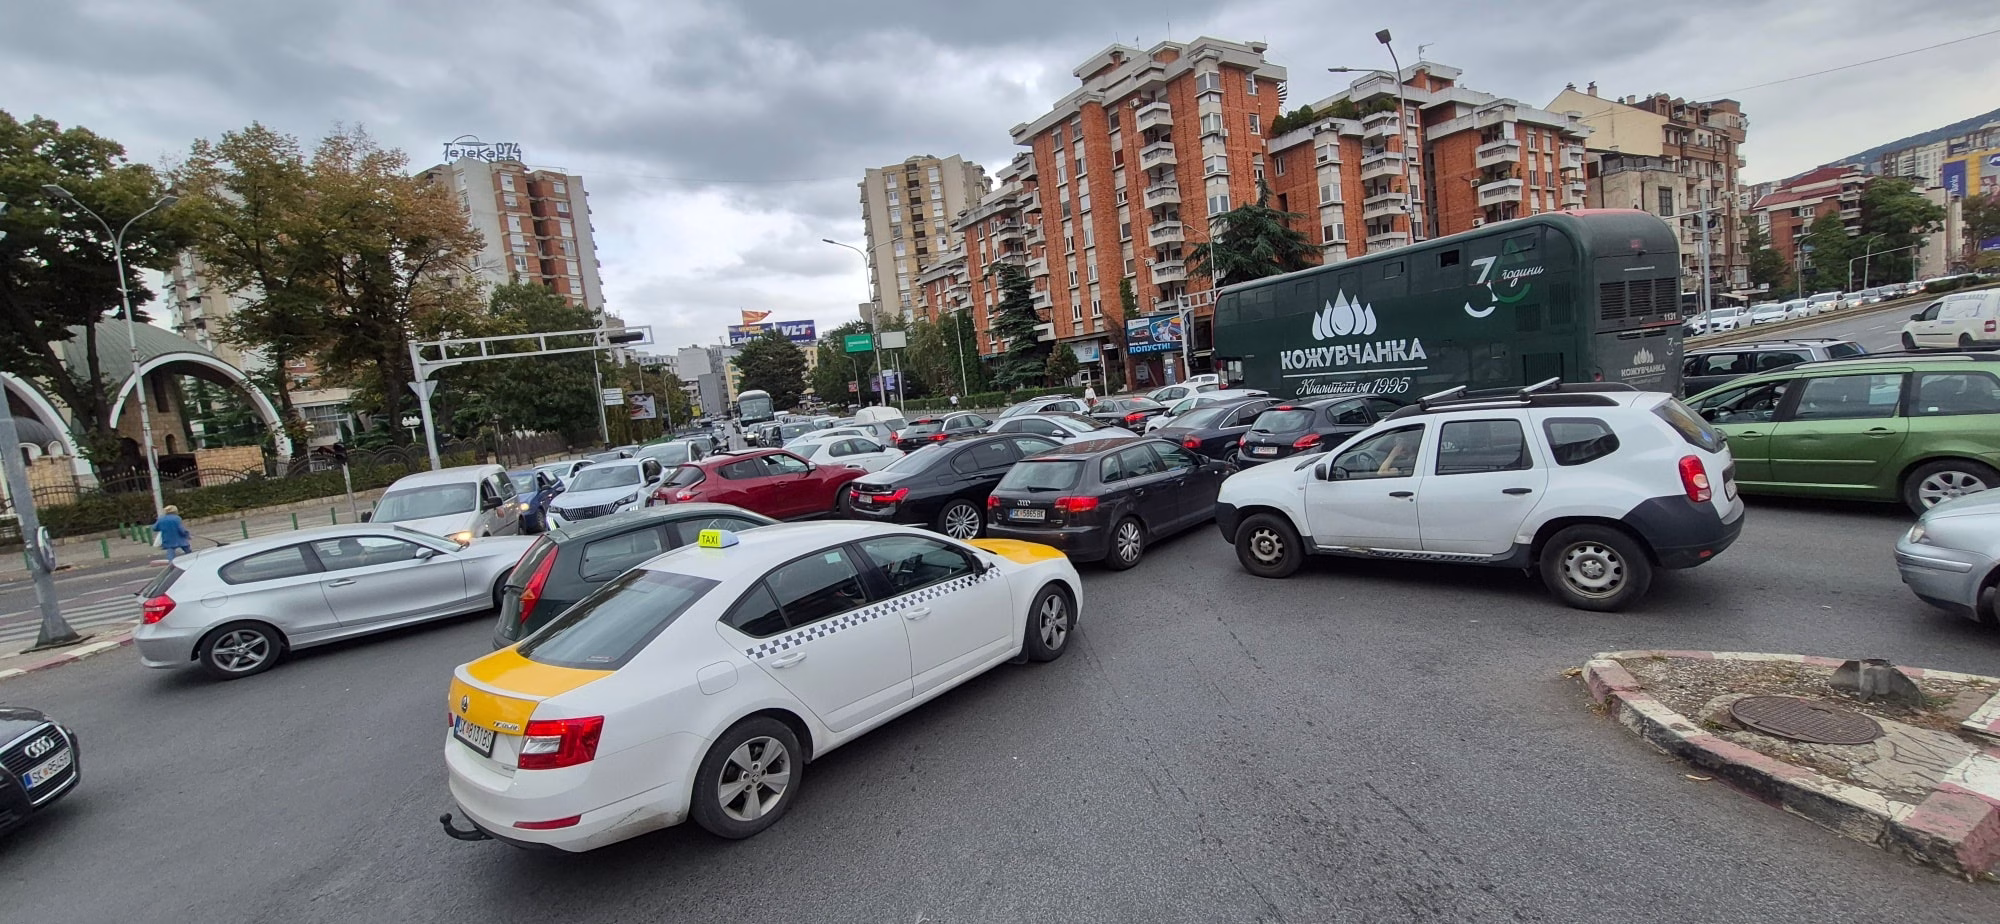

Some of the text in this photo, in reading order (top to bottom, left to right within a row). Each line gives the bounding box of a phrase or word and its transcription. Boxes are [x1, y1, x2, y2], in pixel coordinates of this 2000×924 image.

[781, 325, 809, 336] VLT
[1129, 343, 1171, 353] ПОПУСТИ!
[1280, 337, 1427, 370] КОЖУВЧАНКА
[1371, 376, 1411, 394] 1995
[701, 534, 718, 545] TAXI
[31, 771, 44, 784] SK
